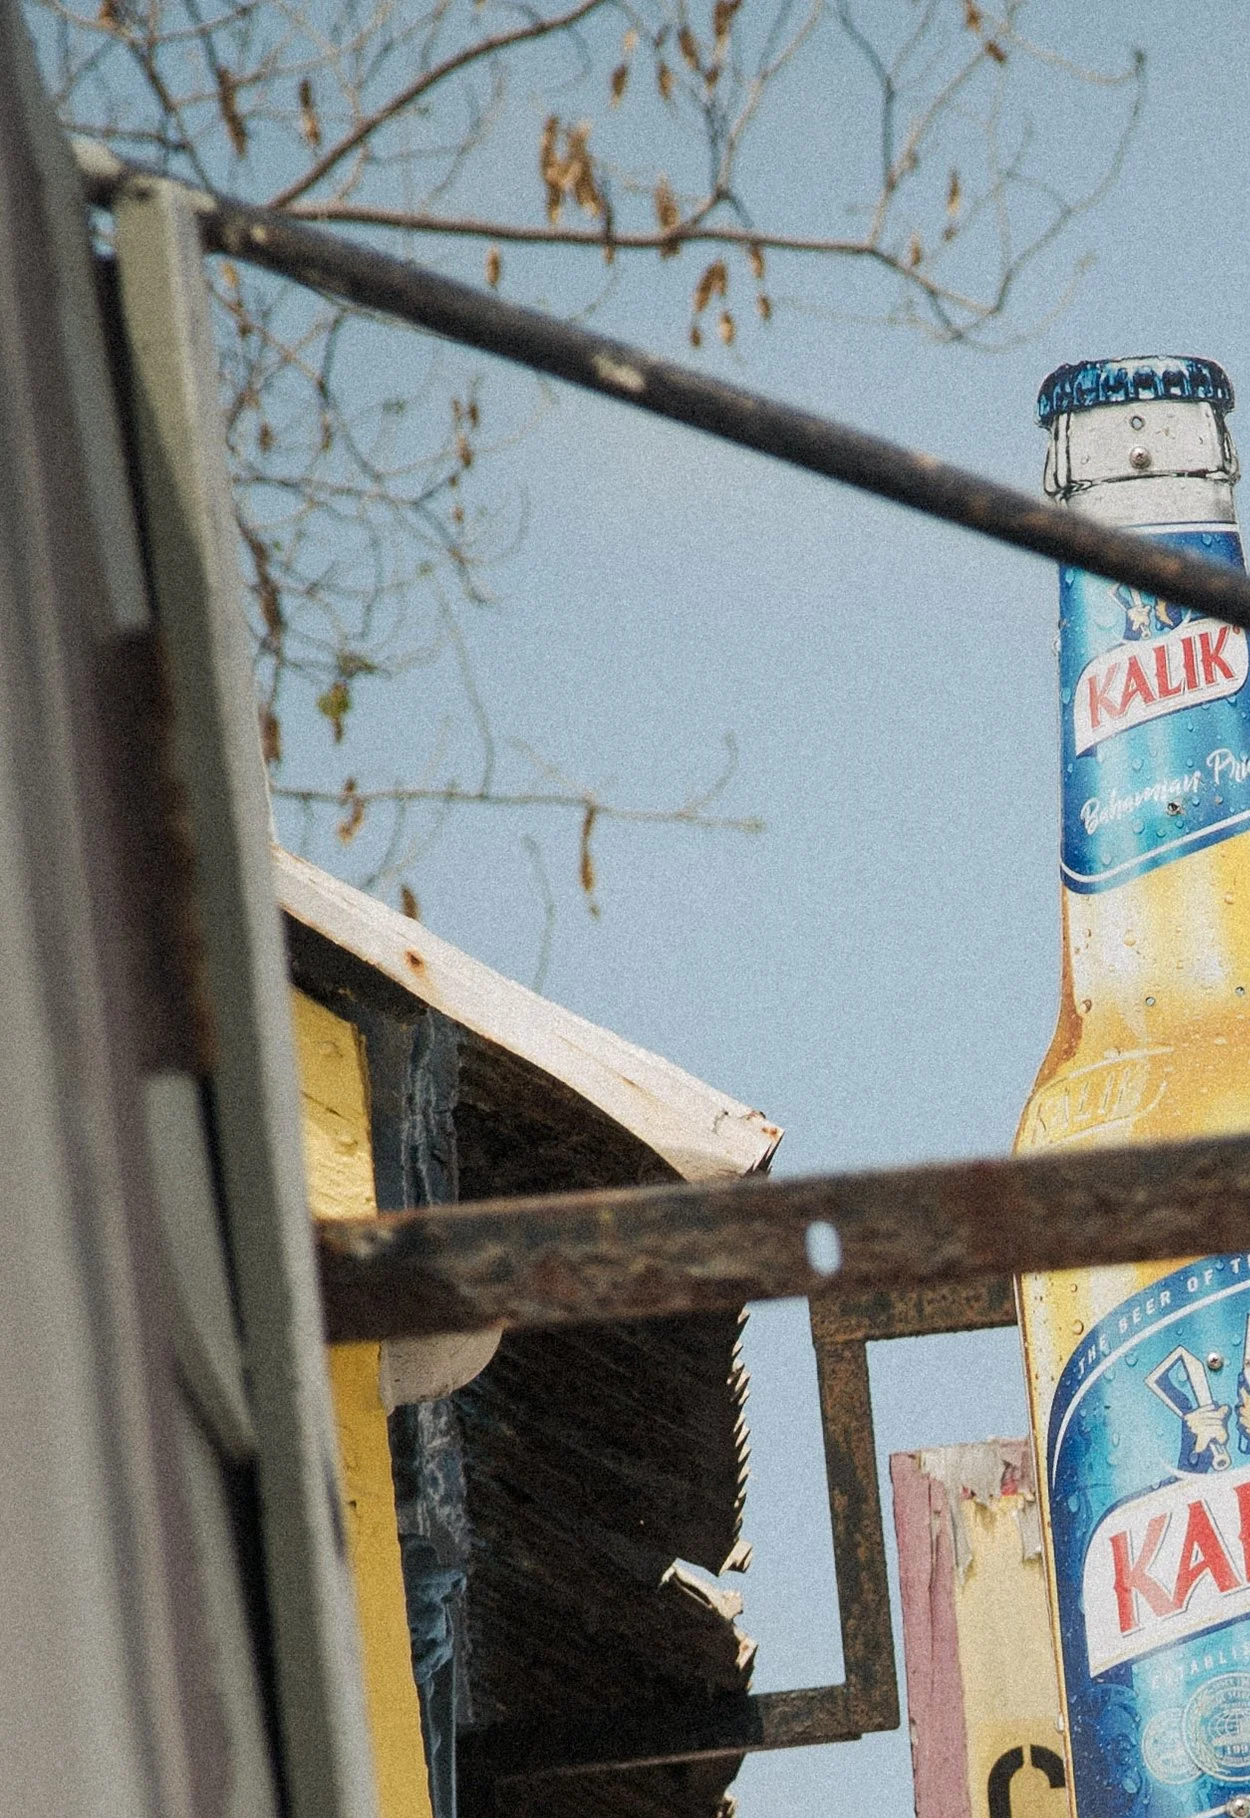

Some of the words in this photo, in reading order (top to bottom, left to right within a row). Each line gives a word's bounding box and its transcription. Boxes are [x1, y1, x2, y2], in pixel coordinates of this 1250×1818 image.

[1086, 624, 1239, 731] KALIK
[1077, 1330, 1110, 1381] THE
[1118, 1289, 1172, 1338] BEER
[1186, 1268, 1217, 1294] OF
